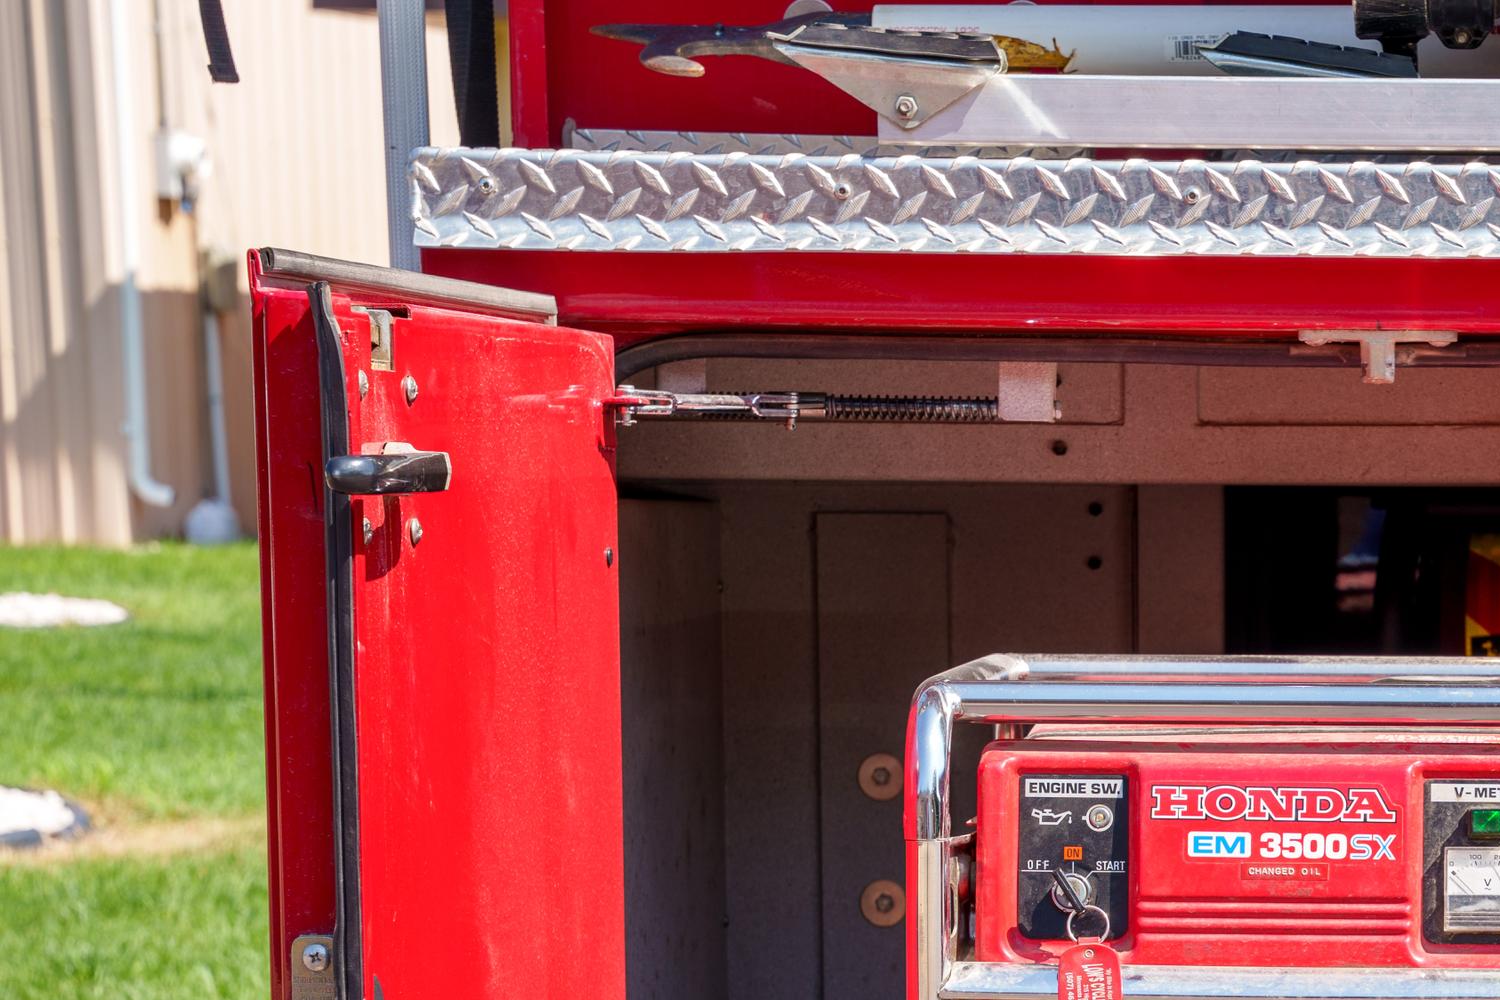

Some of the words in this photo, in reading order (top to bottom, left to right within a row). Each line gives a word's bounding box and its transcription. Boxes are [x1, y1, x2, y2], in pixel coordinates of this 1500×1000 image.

[1028, 782, 1087, 794] ENGINE
[1090, 783, 1120, 795] SW.
[1151, 785, 1397, 823] HONDA
[1191, 834, 1247, 855] EM
[1066, 848, 1080, 858] ON
[1027, 859, 1050, 870] OFF
[1095, 860, 1126, 871] START
[1248, 866, 1296, 876] CHANGED
[1301, 866, 1321, 877] OIL
